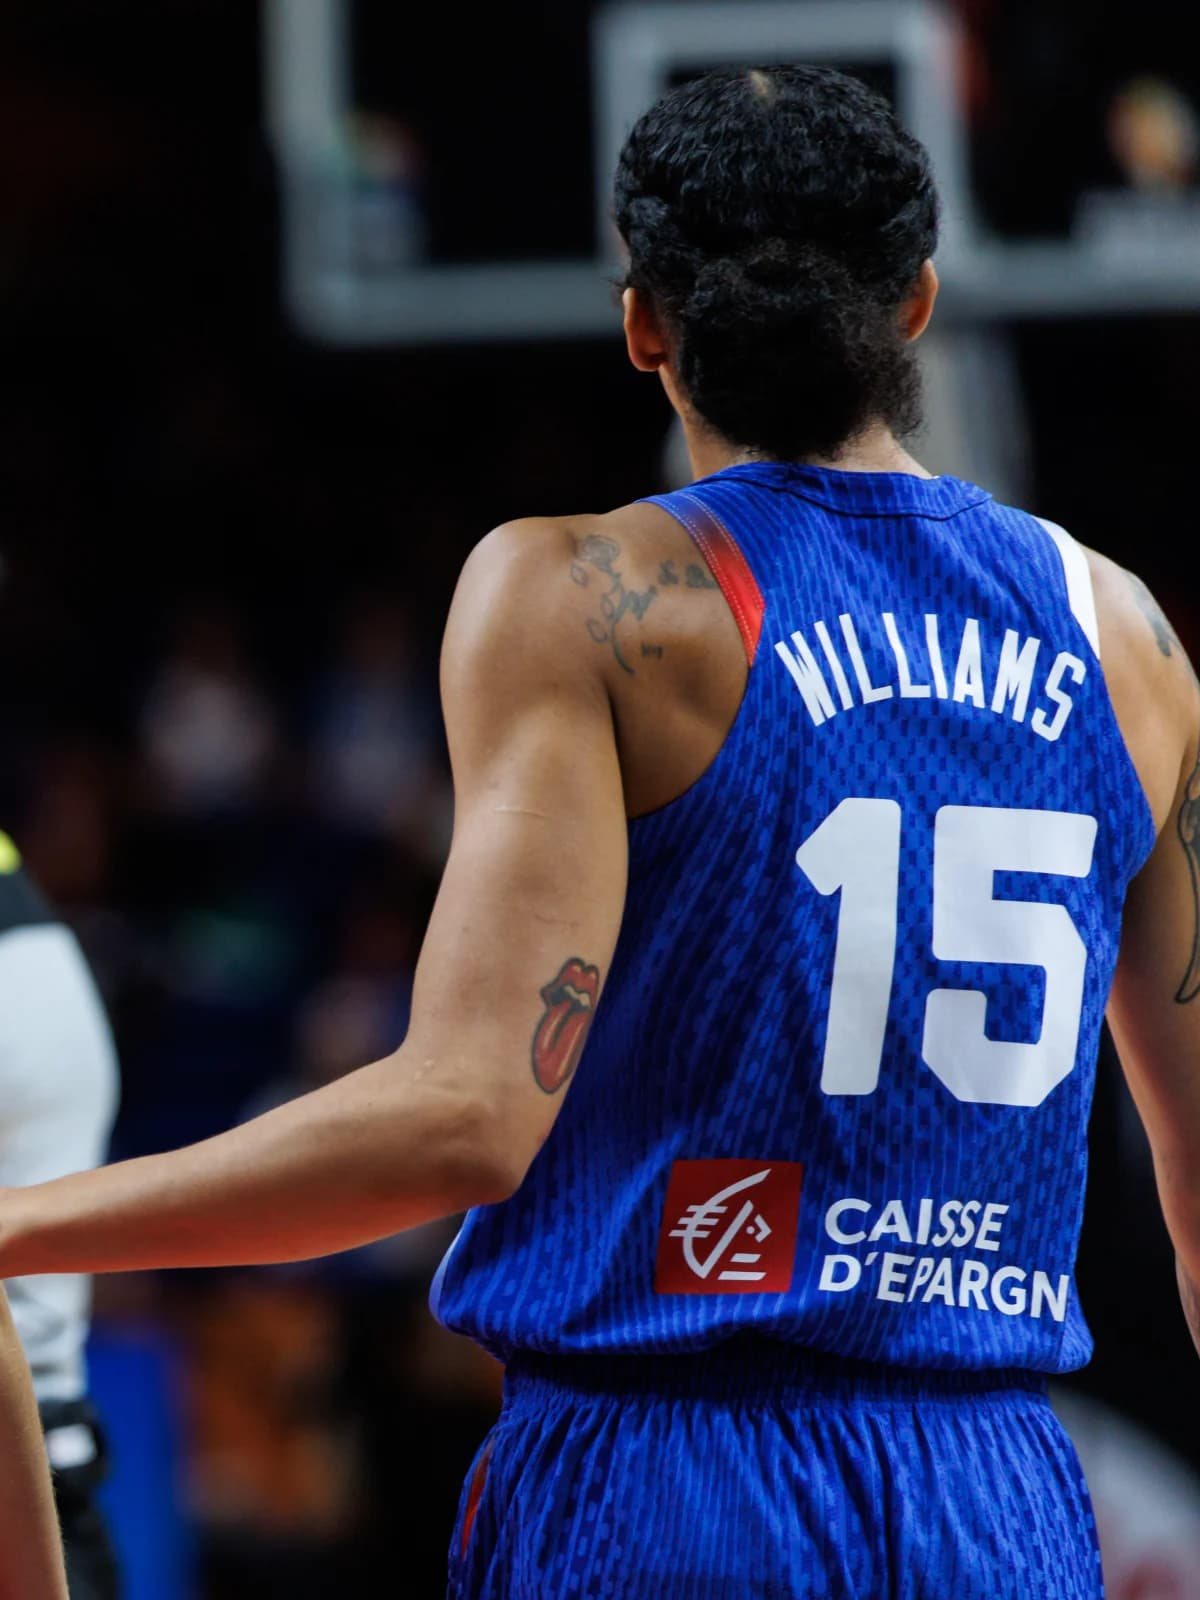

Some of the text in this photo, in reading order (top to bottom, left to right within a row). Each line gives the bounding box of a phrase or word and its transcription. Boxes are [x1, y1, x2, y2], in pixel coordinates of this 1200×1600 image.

[773, 611, 1087, 742] WILLIAMS
[795, 796, 1099, 1108] 15
[824, 1197, 1010, 1252] CAISSE
[817, 1251, 1070, 1322] D'EPARGN
